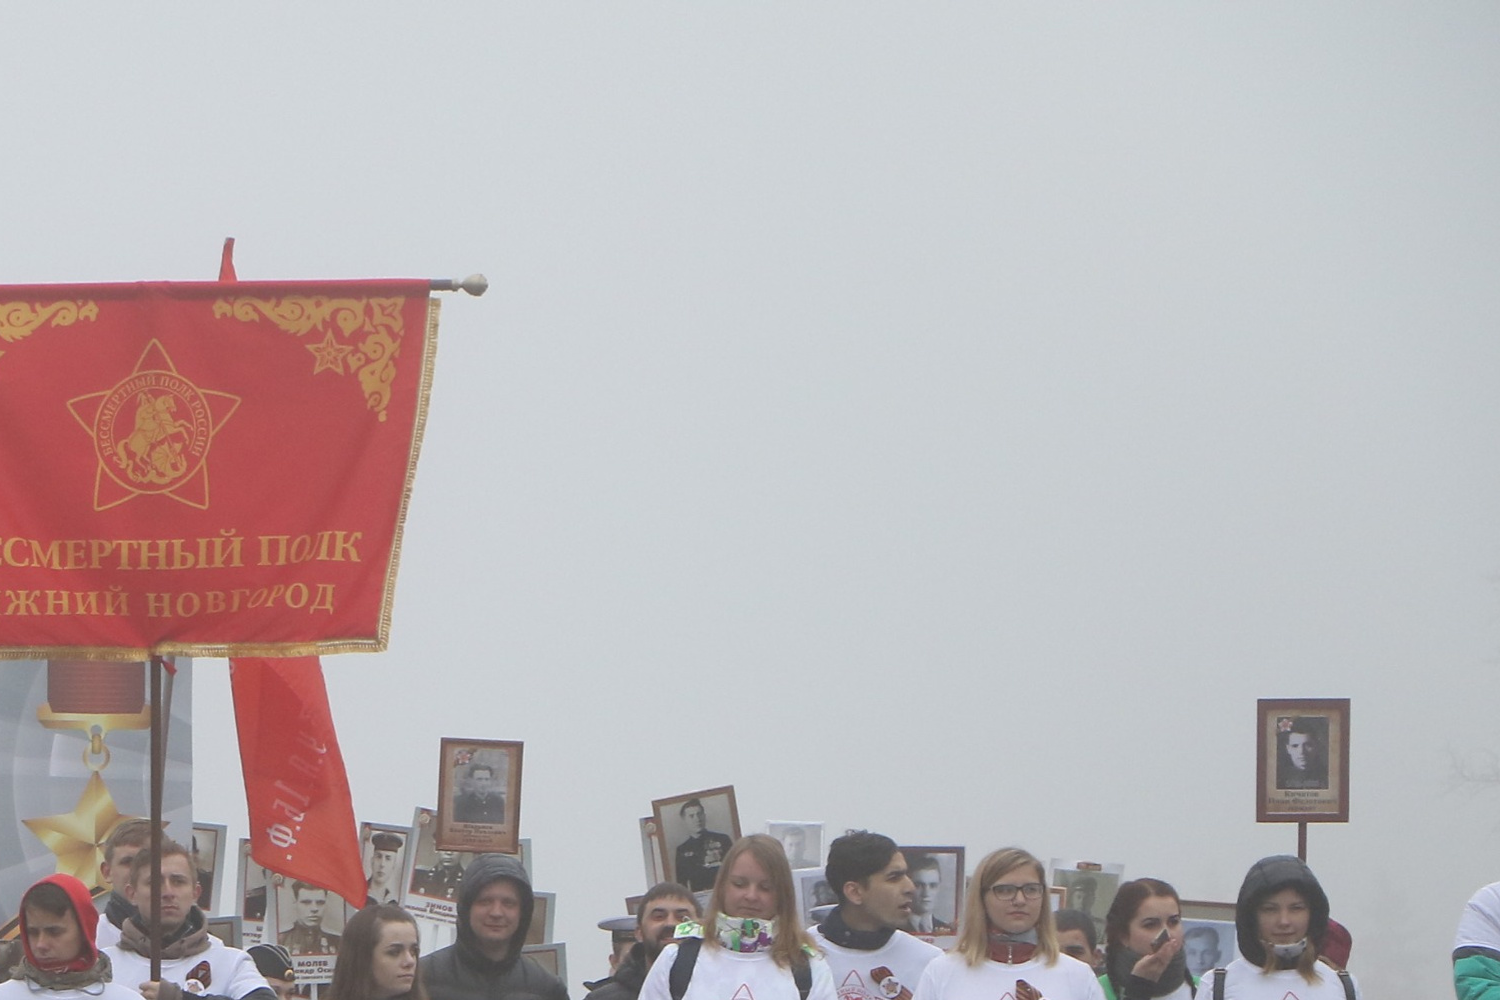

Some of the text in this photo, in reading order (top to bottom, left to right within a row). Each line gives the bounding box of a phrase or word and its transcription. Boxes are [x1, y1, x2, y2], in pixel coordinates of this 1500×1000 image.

[100, 375, 208, 456] БЕССМЕРТНЫЙ ПОЛК РОССИИ
[257, 531, 362, 565] ПОЛК
[146, 583, 336, 618] НОВГОРОД
